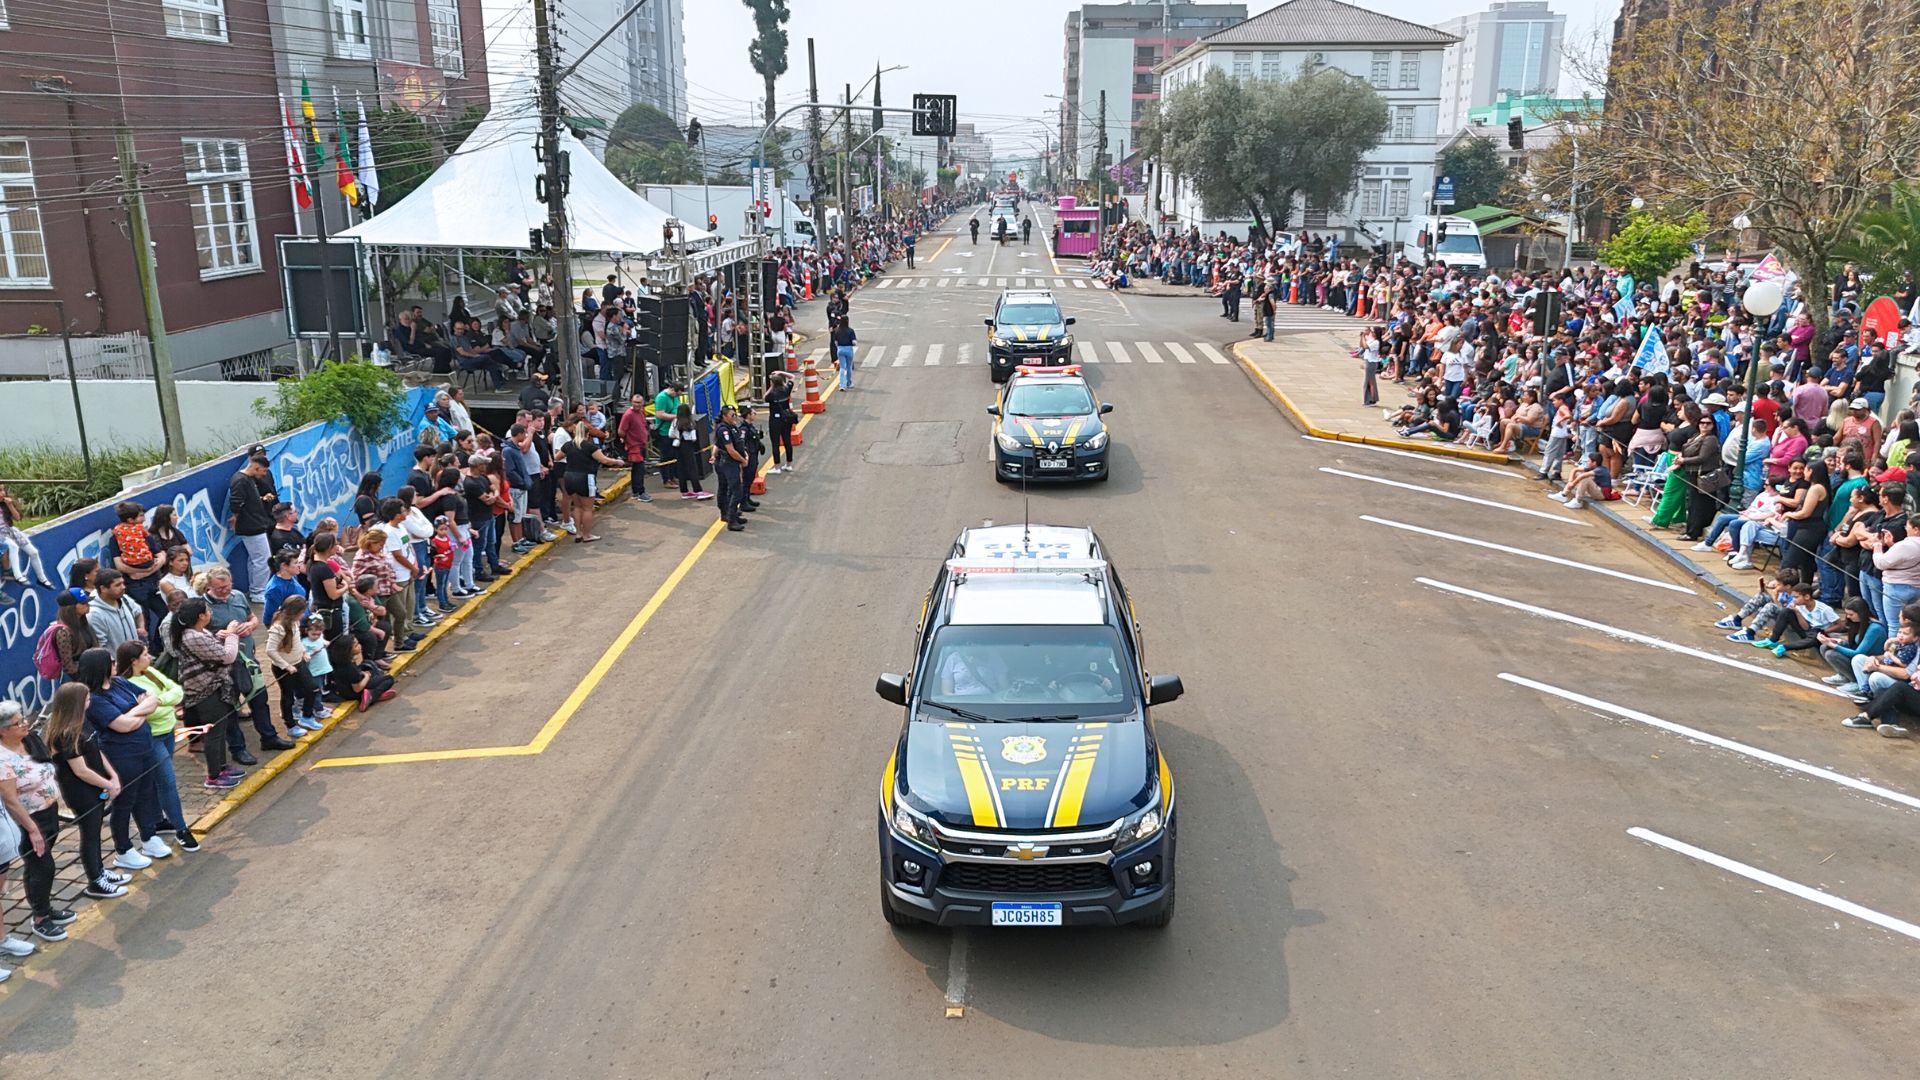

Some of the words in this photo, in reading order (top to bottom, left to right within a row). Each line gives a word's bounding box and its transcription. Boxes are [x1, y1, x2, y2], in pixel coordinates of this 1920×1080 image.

[0, 588, 39, 650] DO
[1001, 778, 1049, 791] PRF
[1000, 910, 1054, 922] JCQ5H85
